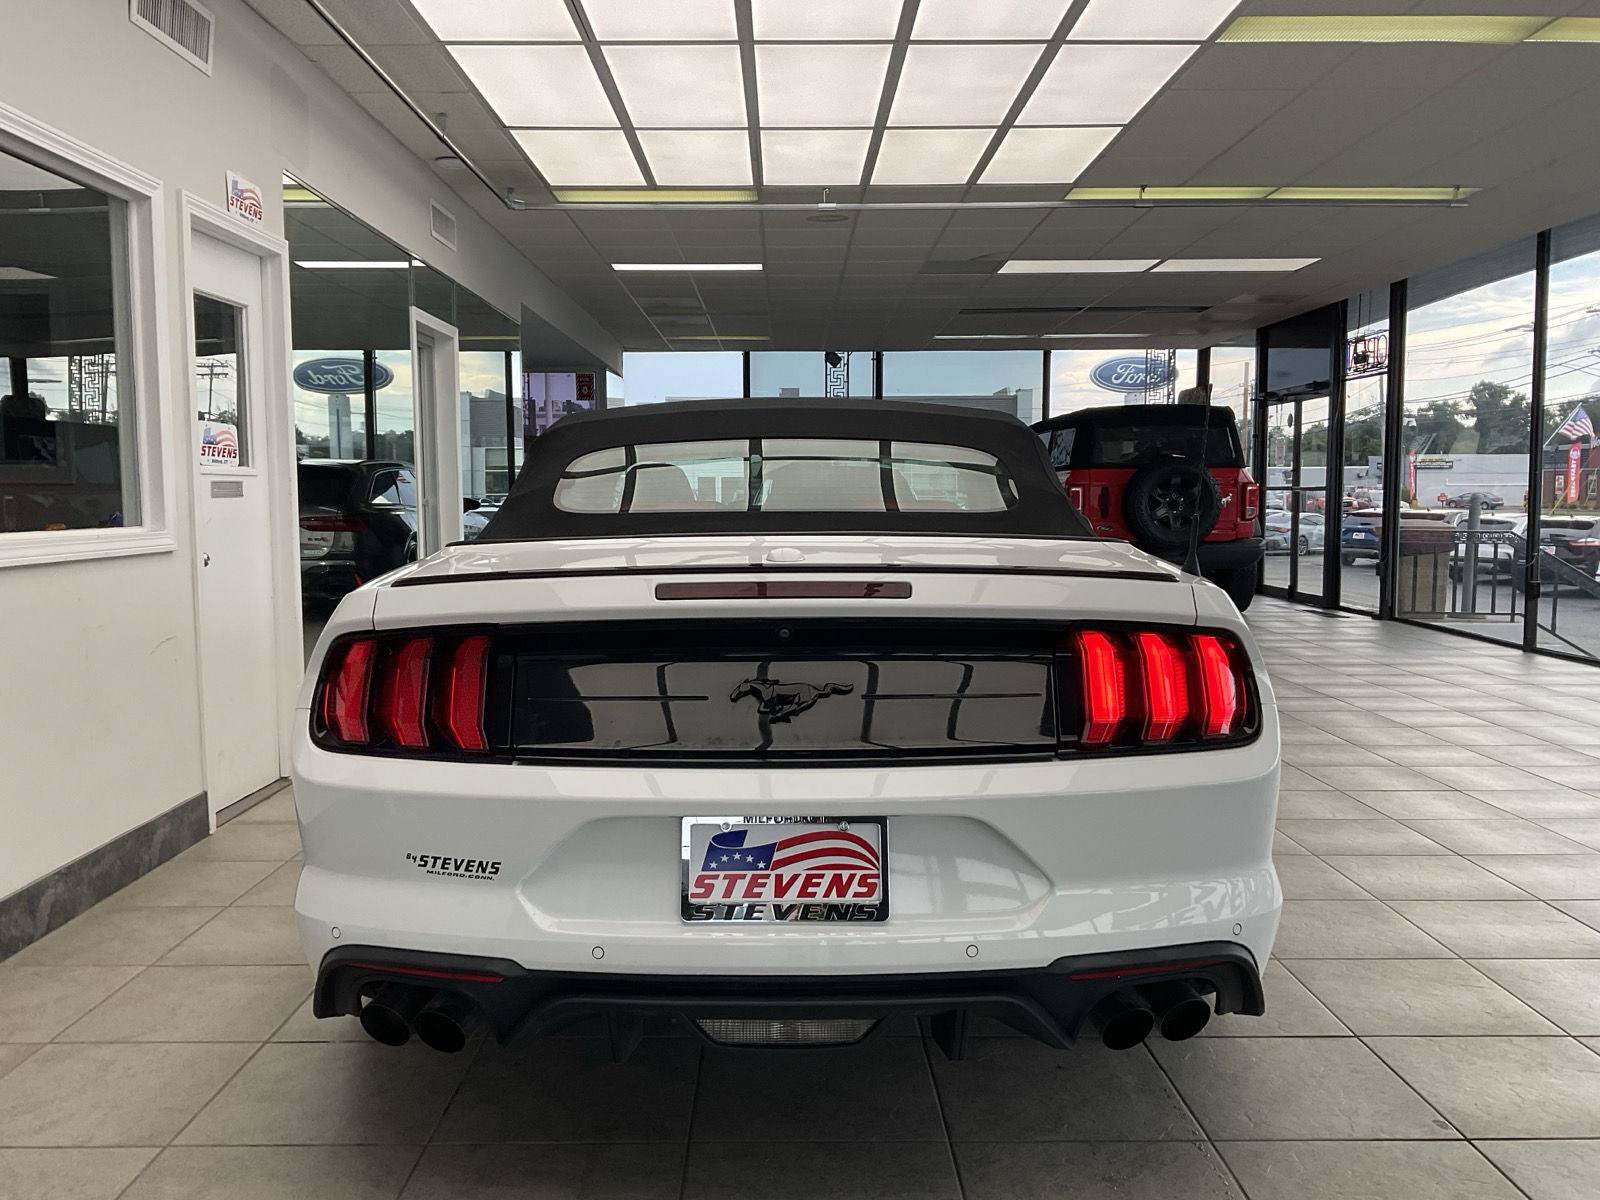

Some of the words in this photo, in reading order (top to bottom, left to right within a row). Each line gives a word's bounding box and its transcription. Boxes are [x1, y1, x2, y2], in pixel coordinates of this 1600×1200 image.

[230, 196, 262, 220] STEVENS
[201, 446, 237, 458] STEVENS
[418, 855, 501, 875] STEVENS
[690, 873, 880, 899] STEVENS
[691, 903, 879, 921] STEVENS
